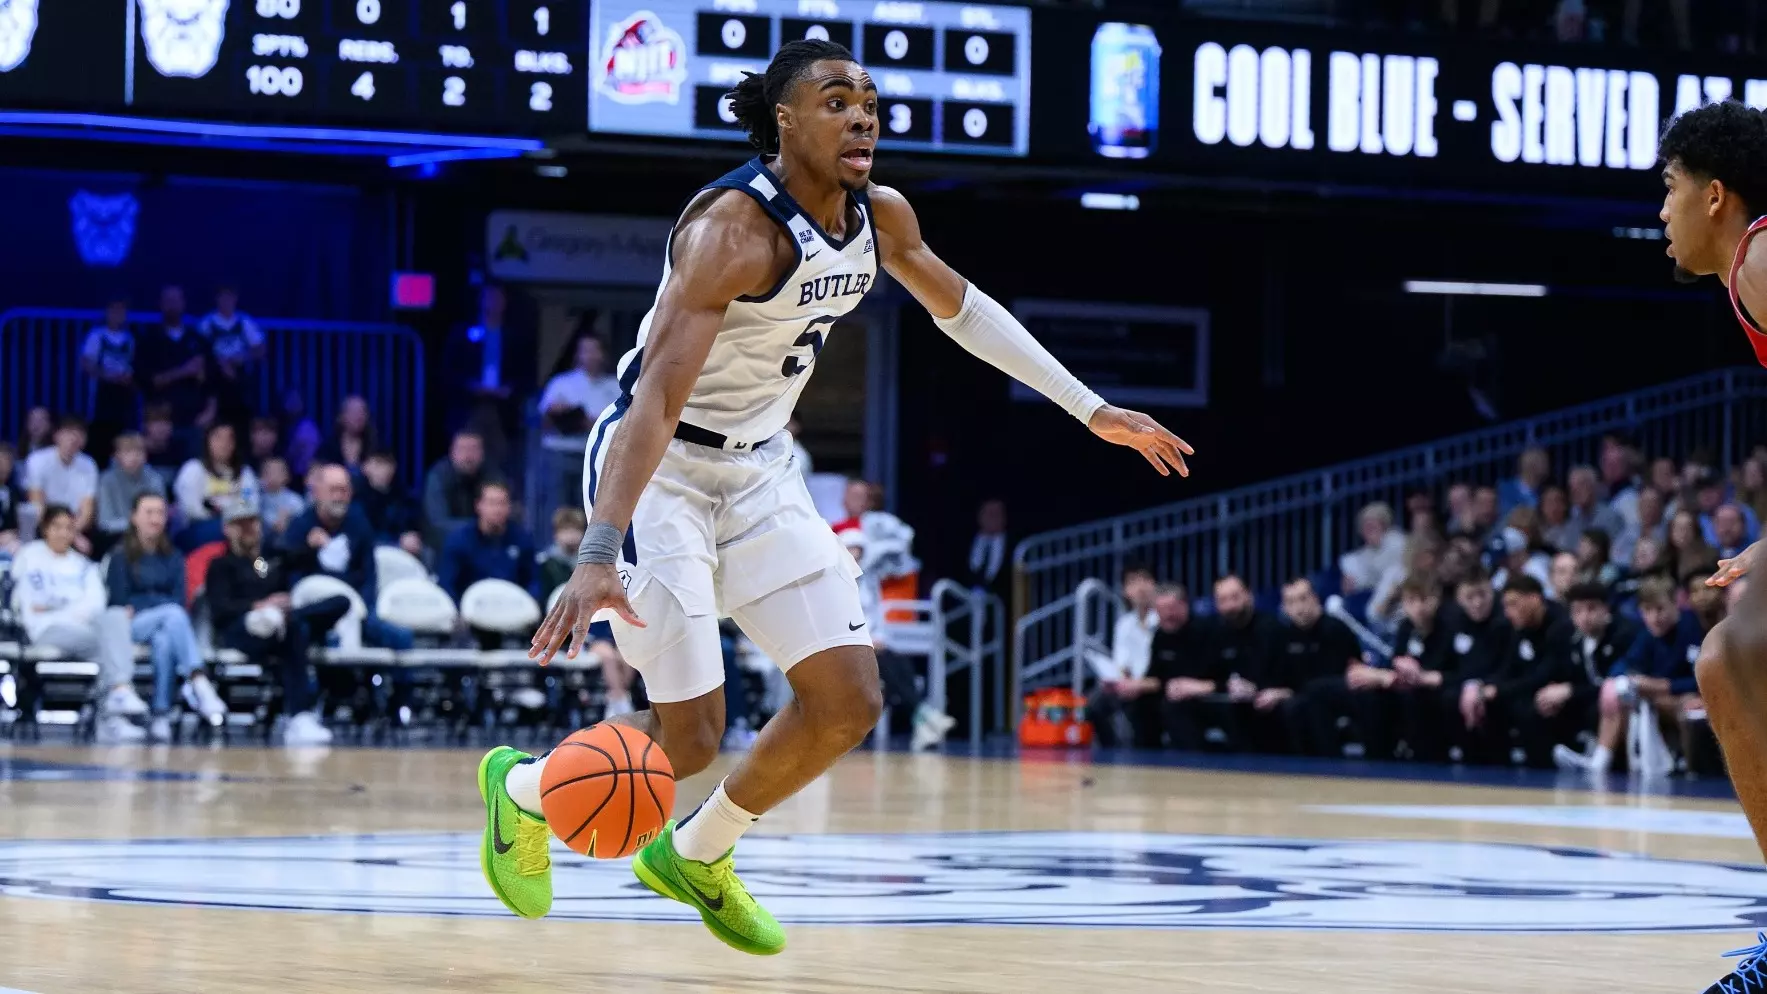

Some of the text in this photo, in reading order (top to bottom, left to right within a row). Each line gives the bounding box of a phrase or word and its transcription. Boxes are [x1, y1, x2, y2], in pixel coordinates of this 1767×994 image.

[451, 1, 466, 30] 1
[534, 6, 550, 35] 1
[721, 19, 746, 49] 0
[884, 30, 909, 60] 0
[965, 35, 989, 65] 0
[246, 65, 303, 96] 100
[351, 71, 376, 101] 4
[442, 76, 466, 106] 2
[529, 81, 553, 111] 2
[1193, 42, 1314, 150] COOL
[1328, 51, 1439, 157] BLUE
[1491, 61, 1660, 170] SERVED
[889, 103, 912, 133] 3
[963, 108, 988, 138] 0
[797, 273, 871, 307] BUTLER
[781, 315, 839, 378] 5
